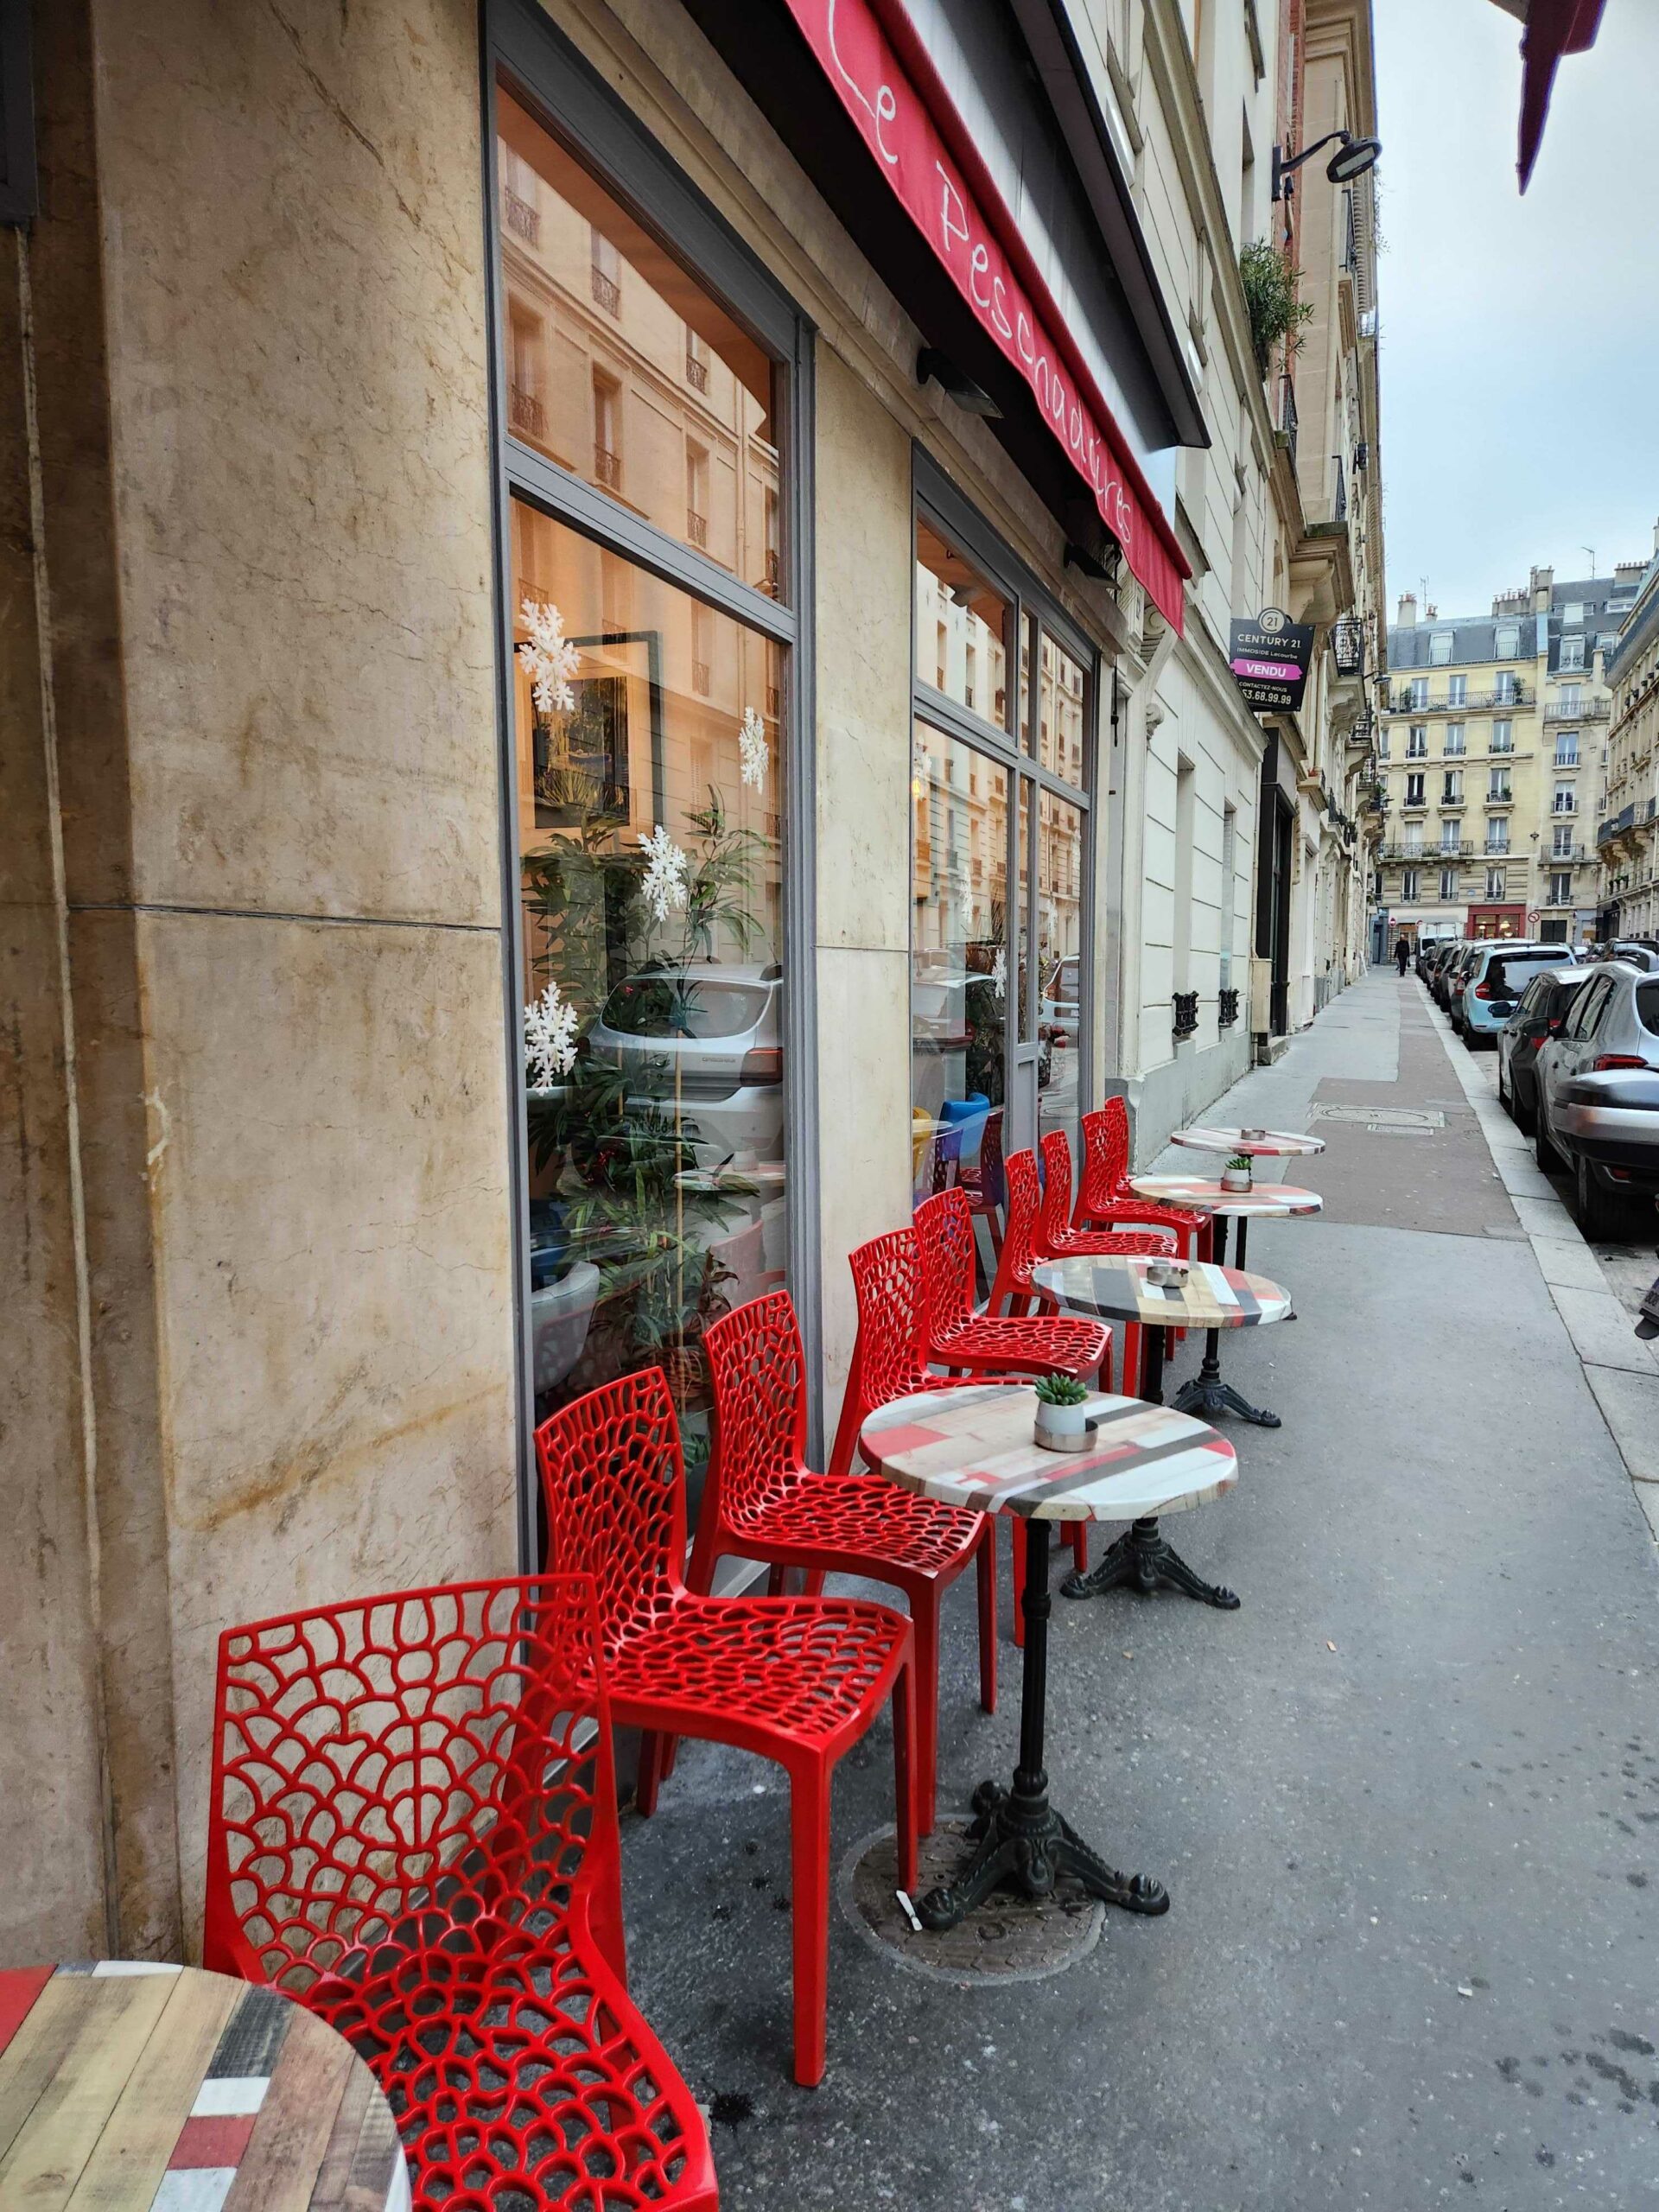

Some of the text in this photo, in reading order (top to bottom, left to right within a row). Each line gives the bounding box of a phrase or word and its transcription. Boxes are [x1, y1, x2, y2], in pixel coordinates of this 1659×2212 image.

[828, 0, 898, 164] Le
[1267, 616, 1278, 627] 21
[1237, 633, 1301, 648] CENTURY 21
[1236, 646, 1269, 656] IMMOSIDE
[1246, 664, 1287, 677] VENDU
